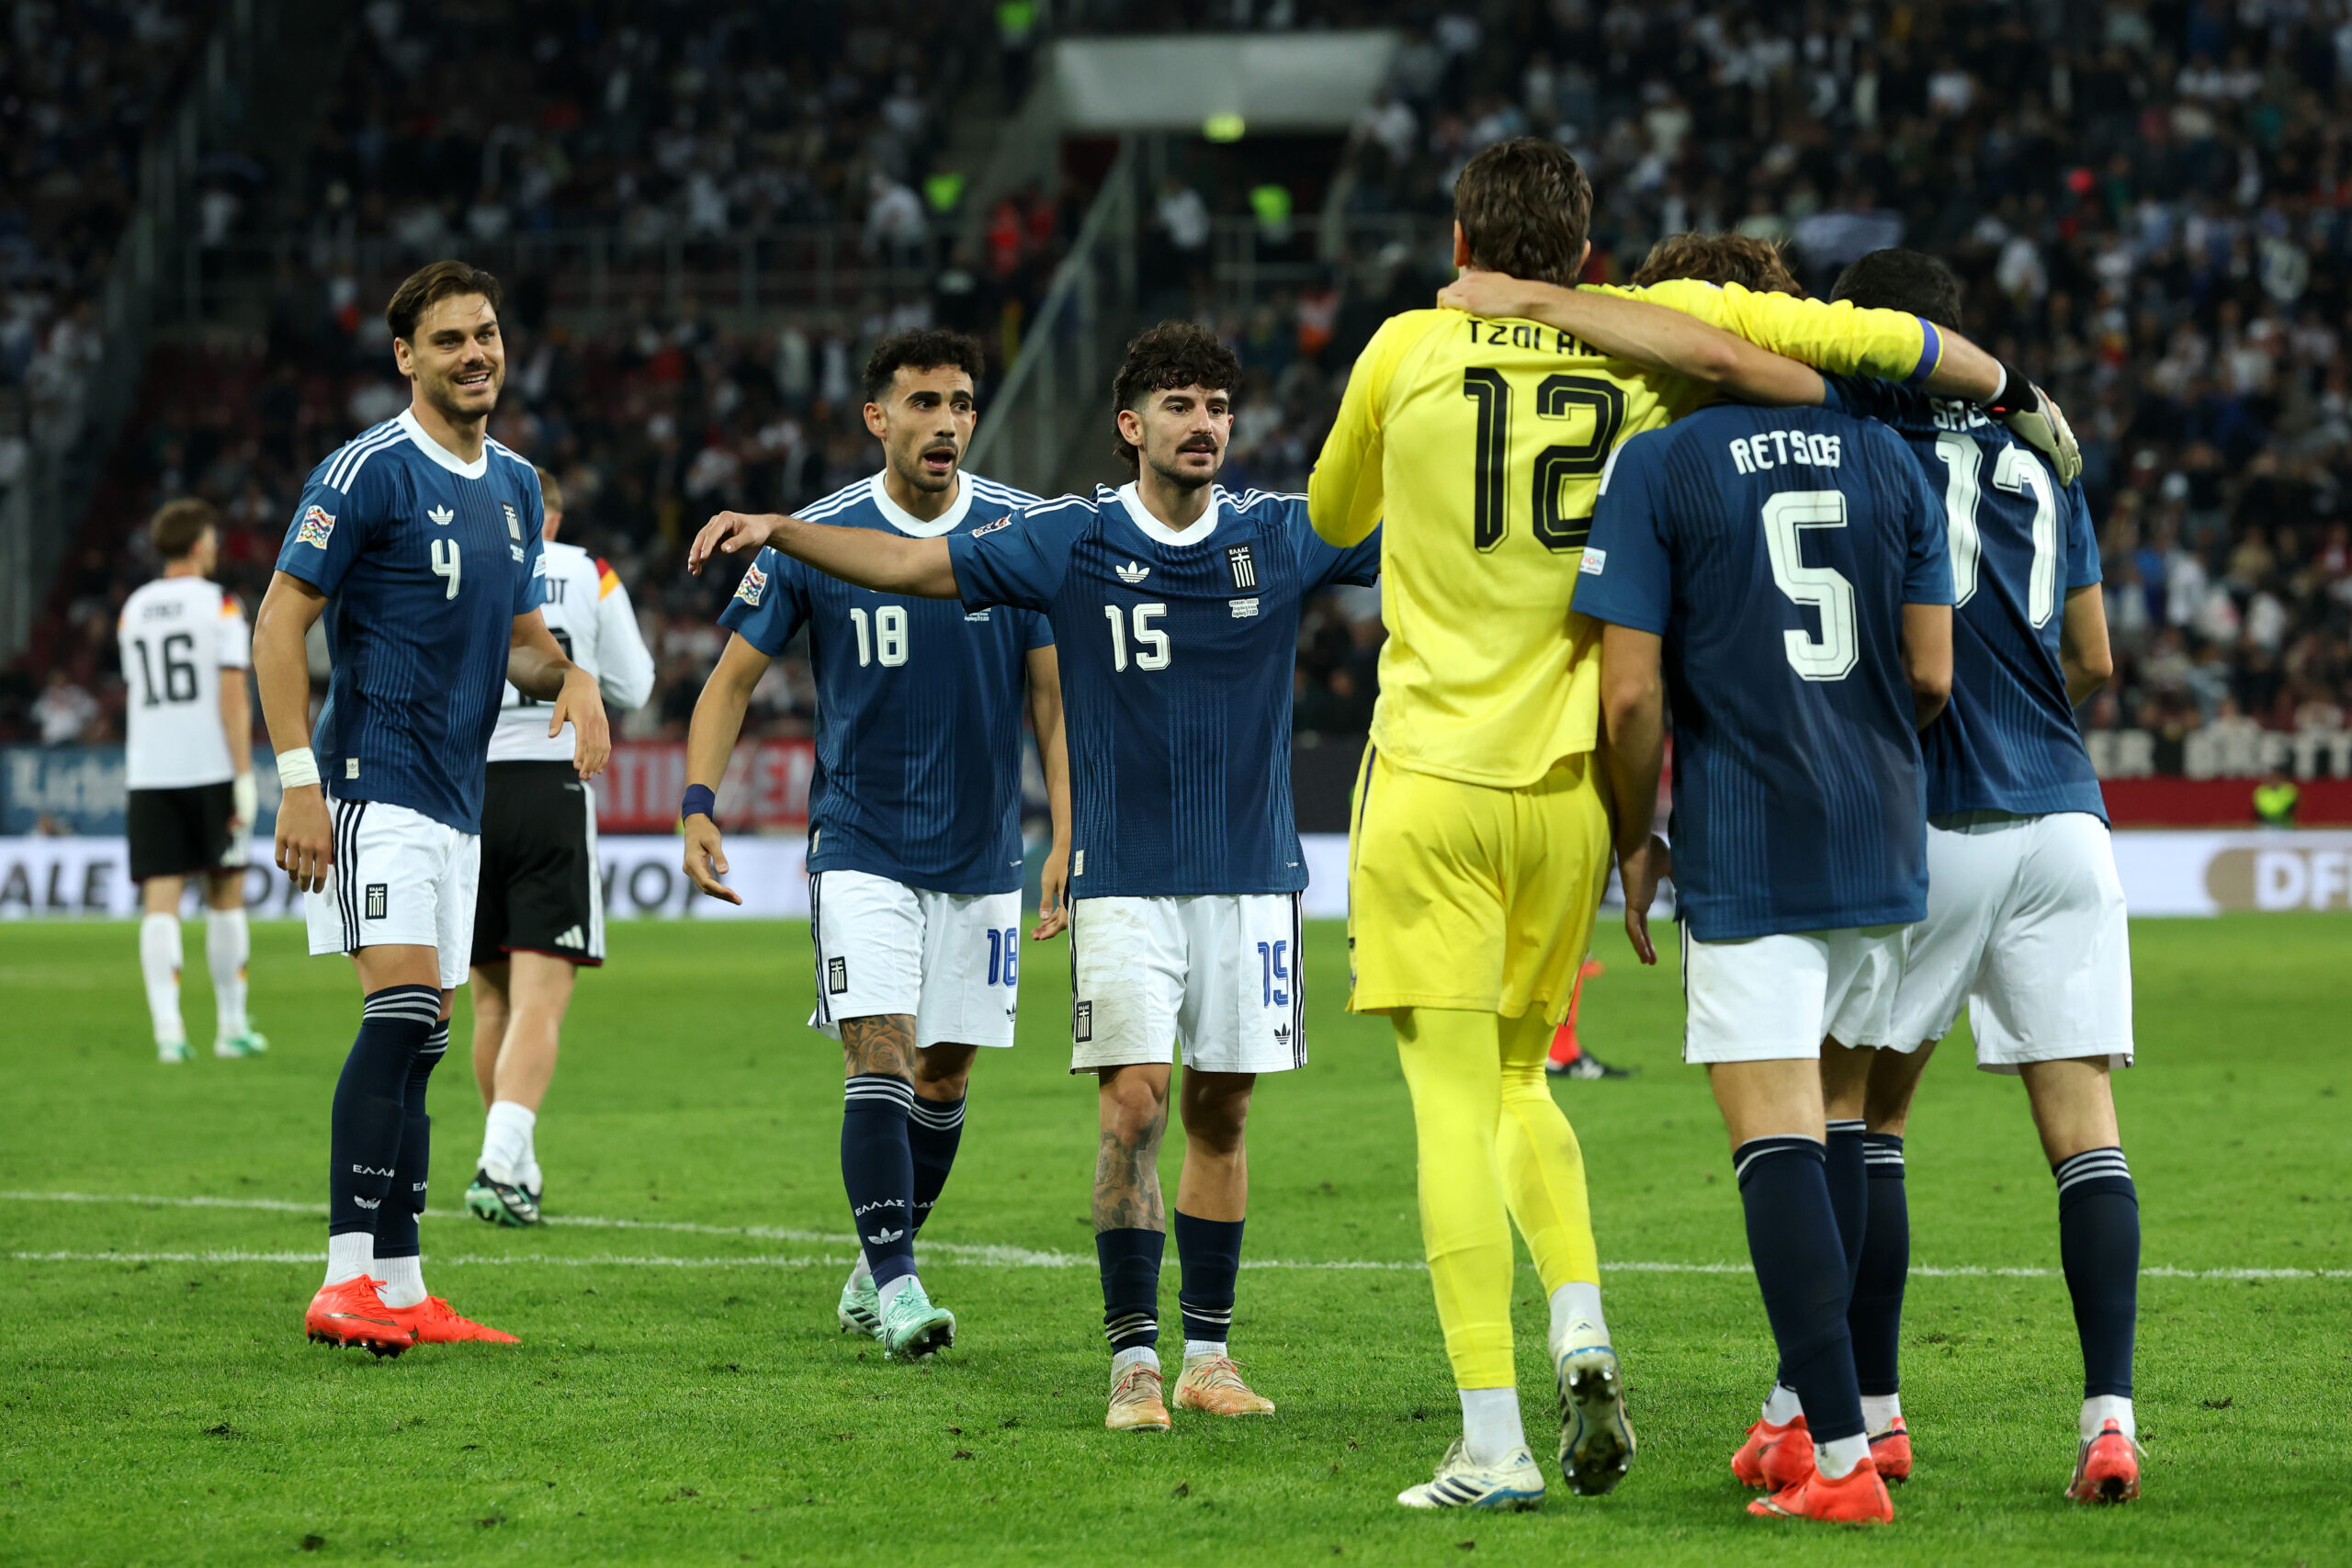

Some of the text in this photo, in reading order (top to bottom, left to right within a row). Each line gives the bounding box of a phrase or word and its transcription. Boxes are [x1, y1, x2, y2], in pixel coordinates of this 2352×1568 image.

[1464, 367, 1629, 555] 12
[1729, 430, 1841, 476] RETSOS
[1935, 431, 2057, 630] 17
[430, 538, 461, 600] 4
[1761, 490, 1860, 682] 5
[135, 634, 198, 706] 16
[850, 605, 909, 667] 18
[1104, 603, 1171, 672] 15
[2254, 850, 2352, 911] DF
[987, 927, 1017, 987] 18
[1257, 939, 1289, 1009] 15
